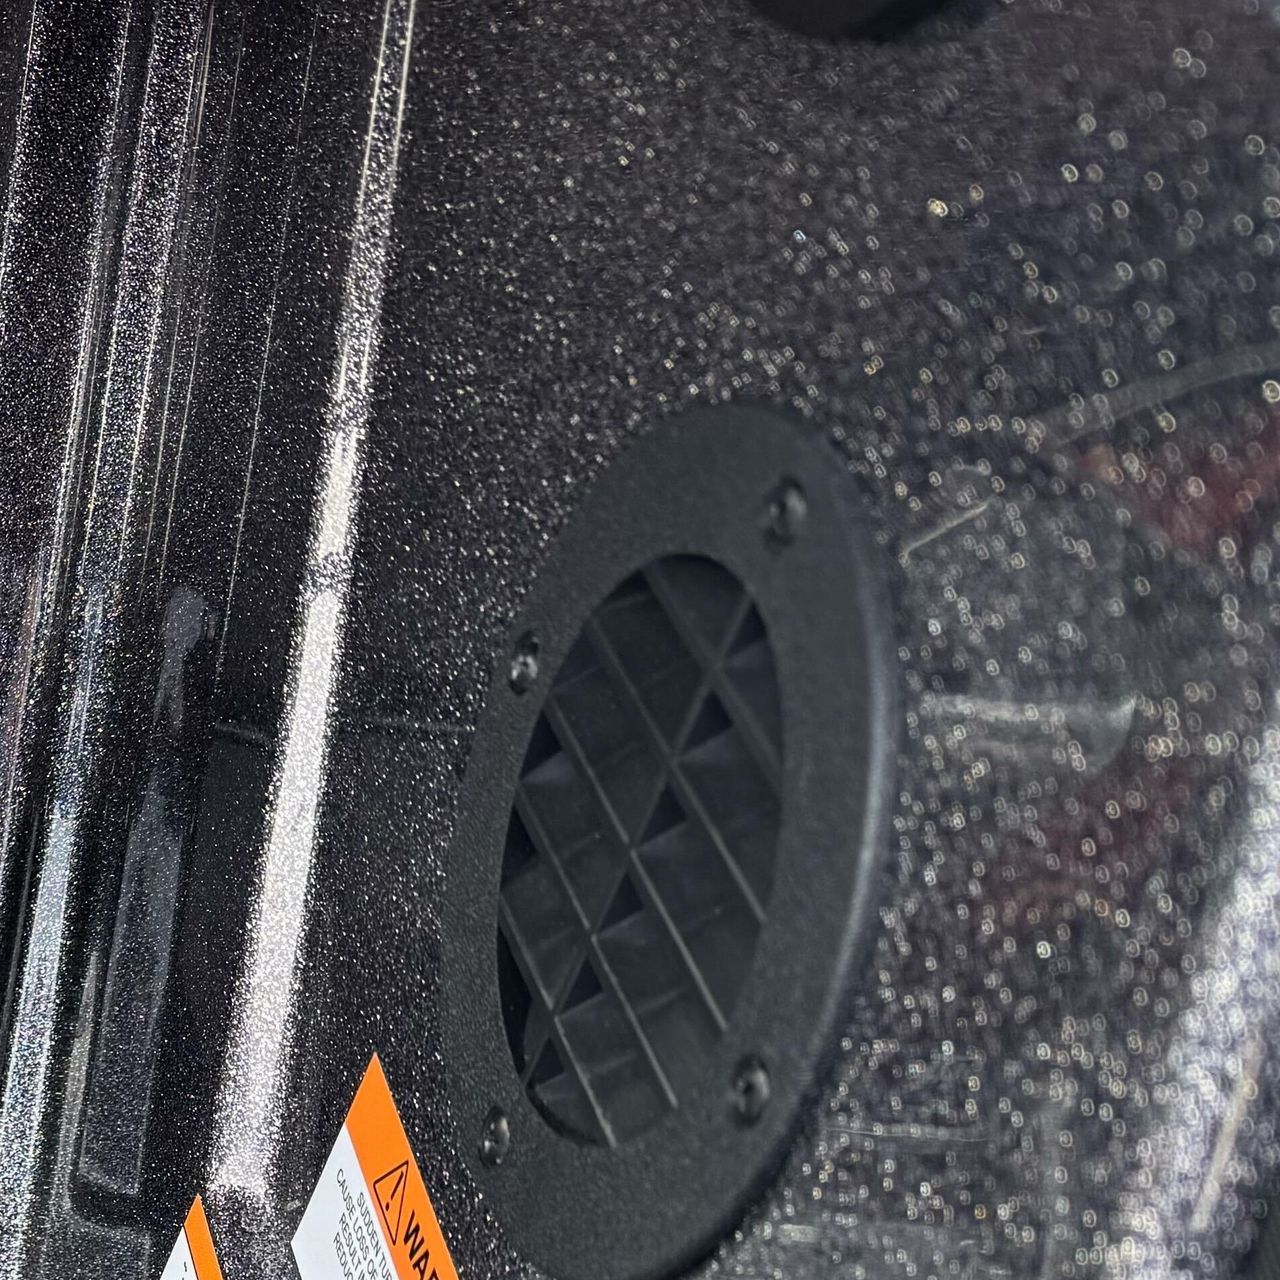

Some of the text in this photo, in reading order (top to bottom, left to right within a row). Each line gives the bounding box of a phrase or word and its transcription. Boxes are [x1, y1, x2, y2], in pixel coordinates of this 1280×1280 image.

[335, 1166, 356, 1222] CAUSE
[352, 1215, 370, 1262] LOSS
[338, 1211, 361, 1273] RESULT
[356, 1189, 381, 1258] SUDDEN
